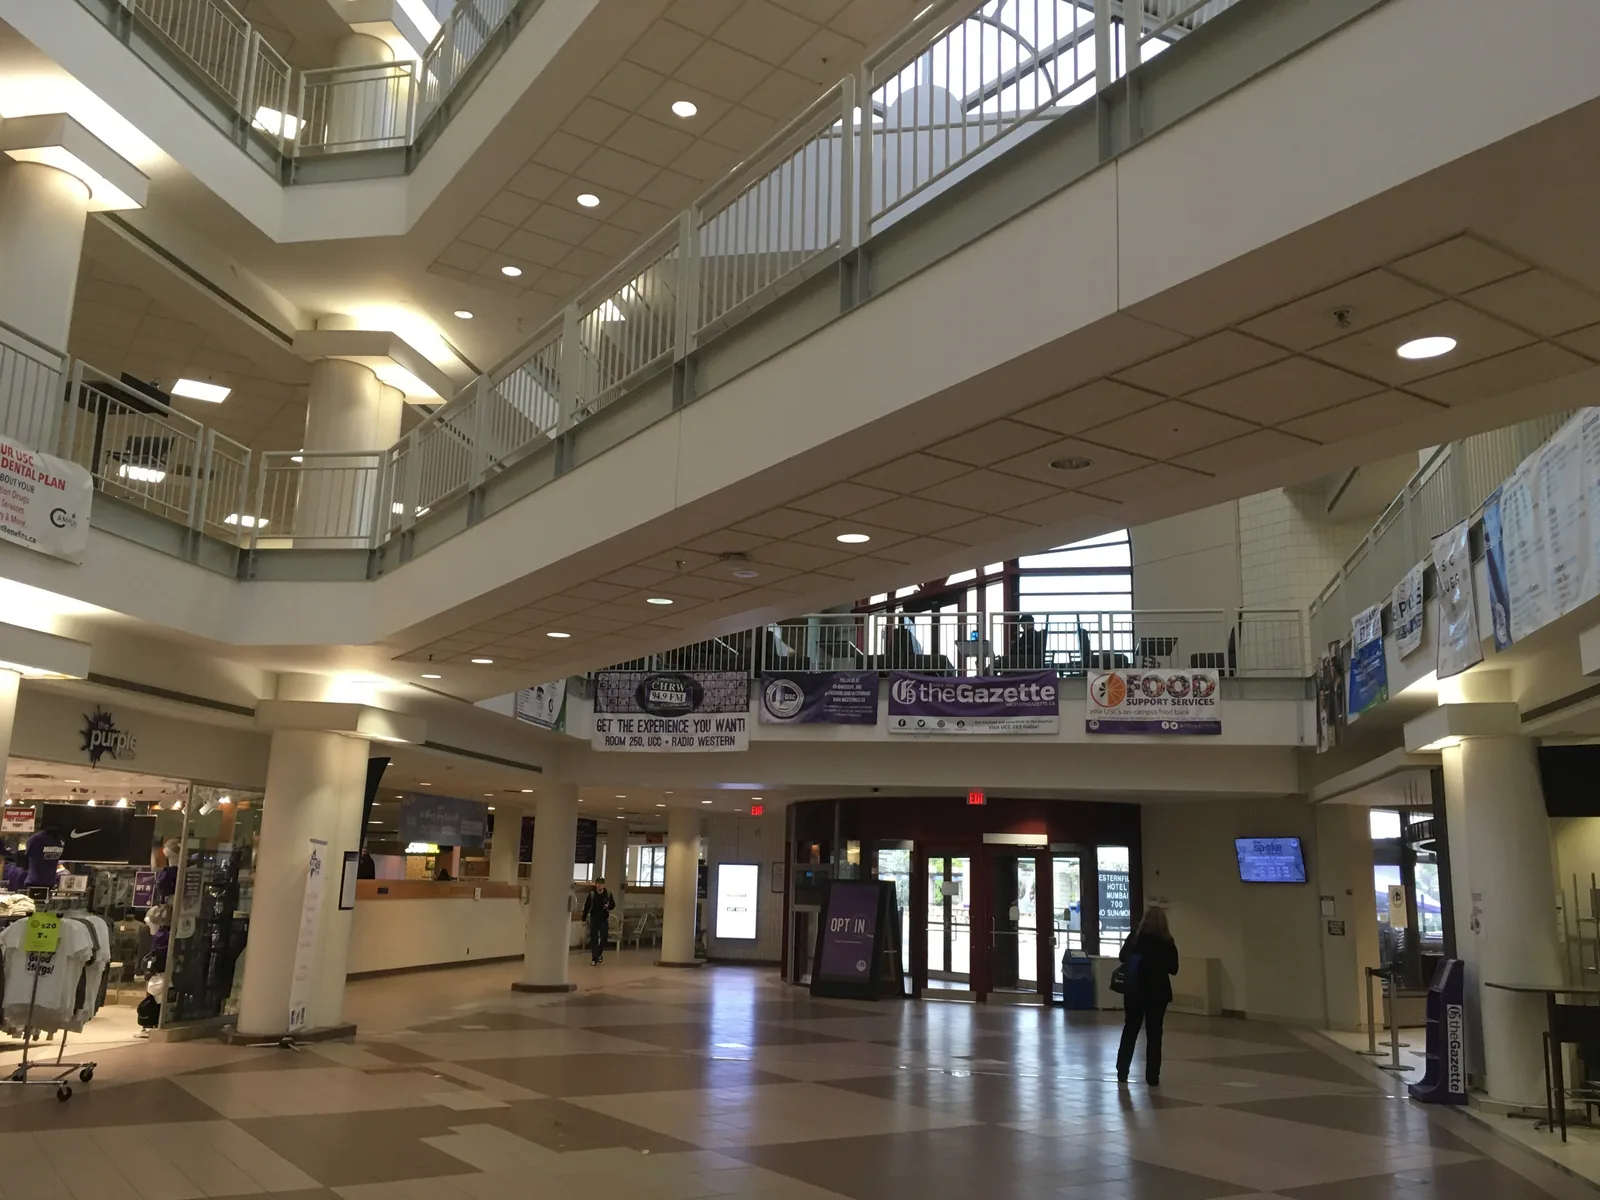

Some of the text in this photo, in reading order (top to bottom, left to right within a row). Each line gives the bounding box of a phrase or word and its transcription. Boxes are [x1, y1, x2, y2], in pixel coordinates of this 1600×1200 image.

[16, 450, 35, 466] USC
[0, 456, 66, 491] DENTAL PLAN
[17, 480, 35, 494] YOUR
[12, 490, 30, 504] Drugs
[652, 681, 685, 692] CHRW
[919, 682, 1056, 703] theGazette
[1126, 674, 1216, 699] FOOD
[651, 691, 684, 702] 94.9 FM
[1126, 698, 1215, 706] SUPPORT SERVICES
[596, 718, 746, 733] GET THE EXPERIENCE YOU WANT!
[90, 729, 137, 754] purple
[605, 736, 736, 747] ROOM 250, UCC RADIO WESTERN
[830, 917, 866, 933] OPT IN
[1449, 1020, 1461, 1092] theGazette
